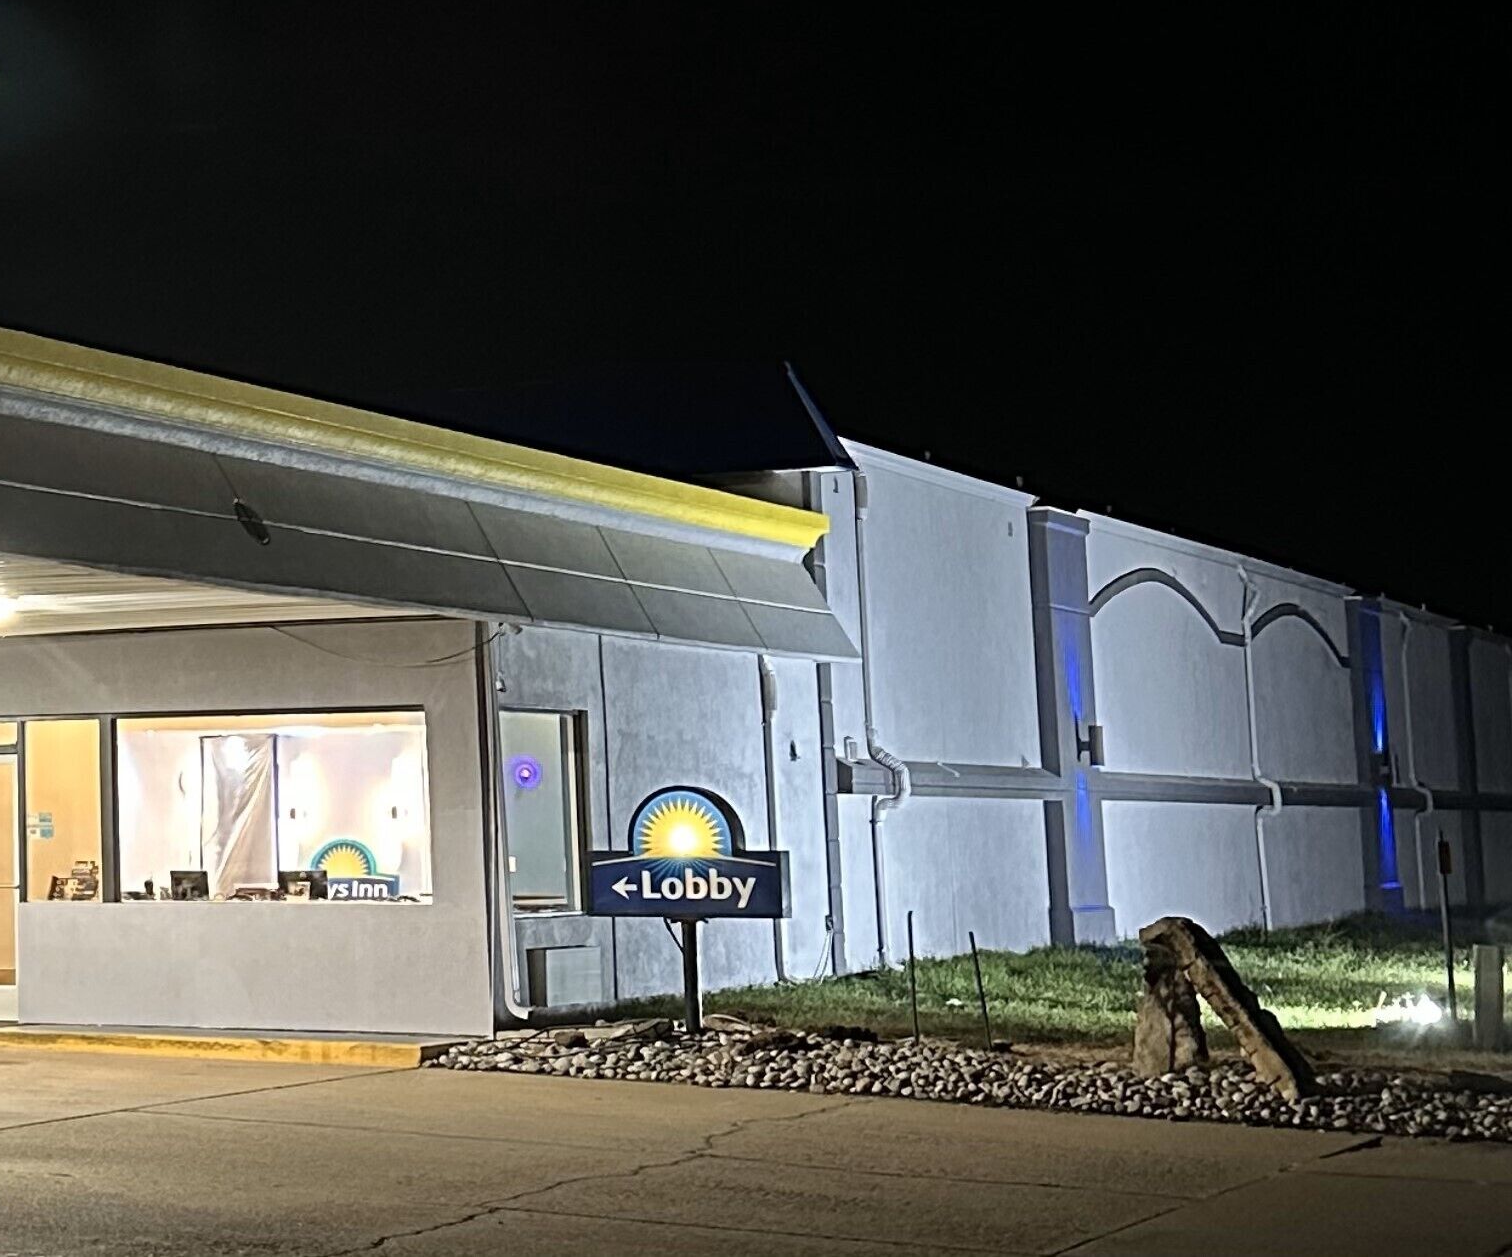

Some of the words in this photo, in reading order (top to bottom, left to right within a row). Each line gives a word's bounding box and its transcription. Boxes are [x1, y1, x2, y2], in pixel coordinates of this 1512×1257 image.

[327, 883, 349, 900] ys
[351, 880, 389, 898] Inn
[641, 868, 756, 908] Lobby
